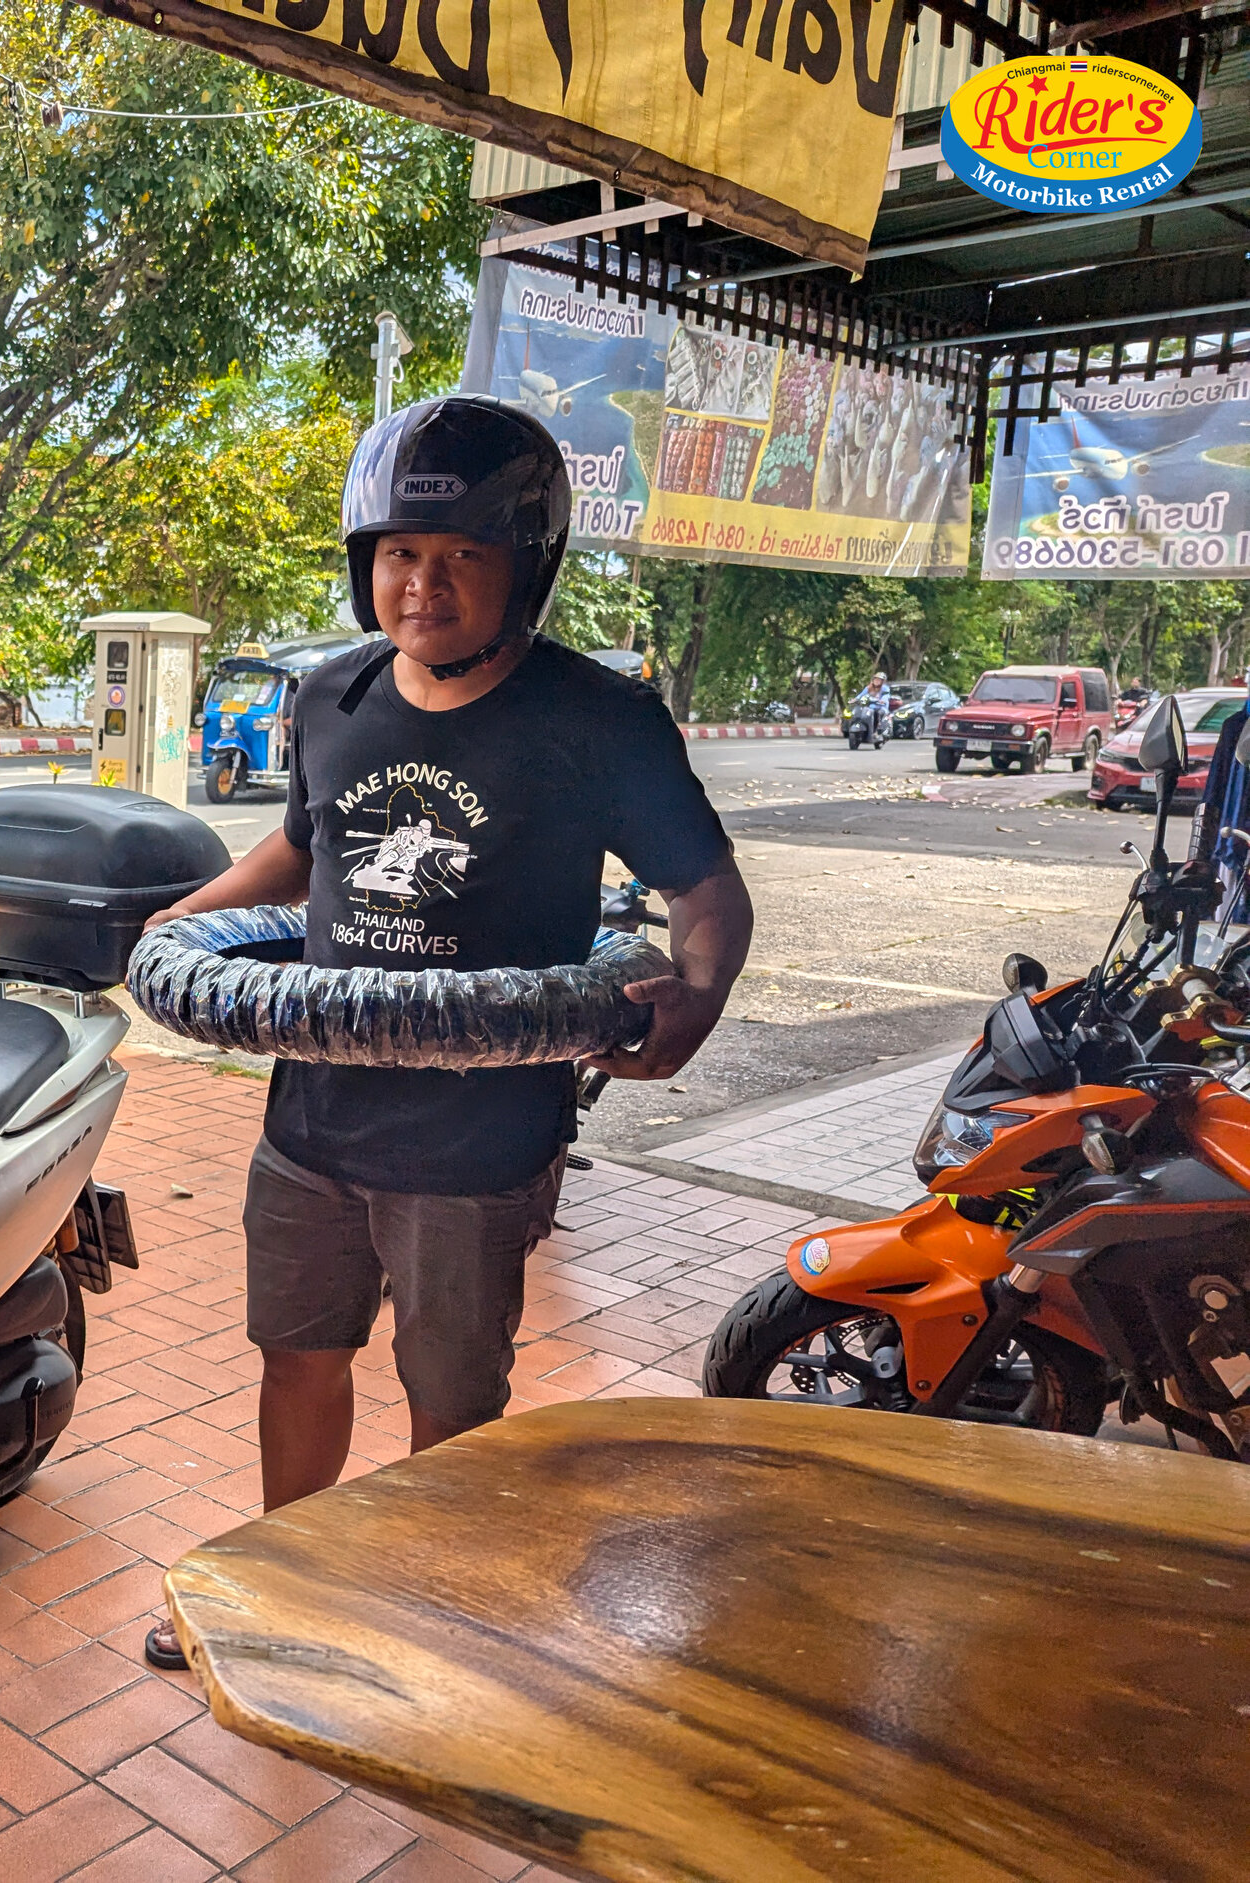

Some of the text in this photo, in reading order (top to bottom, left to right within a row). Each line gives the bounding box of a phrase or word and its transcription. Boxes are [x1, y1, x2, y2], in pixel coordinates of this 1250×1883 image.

[403, 480, 455, 495] INDEX
[335, 762, 489, 828] MAE HONG SON
[353, 911, 425, 932] THAILAND
[331, 923, 458, 955] 1864 CURVES
